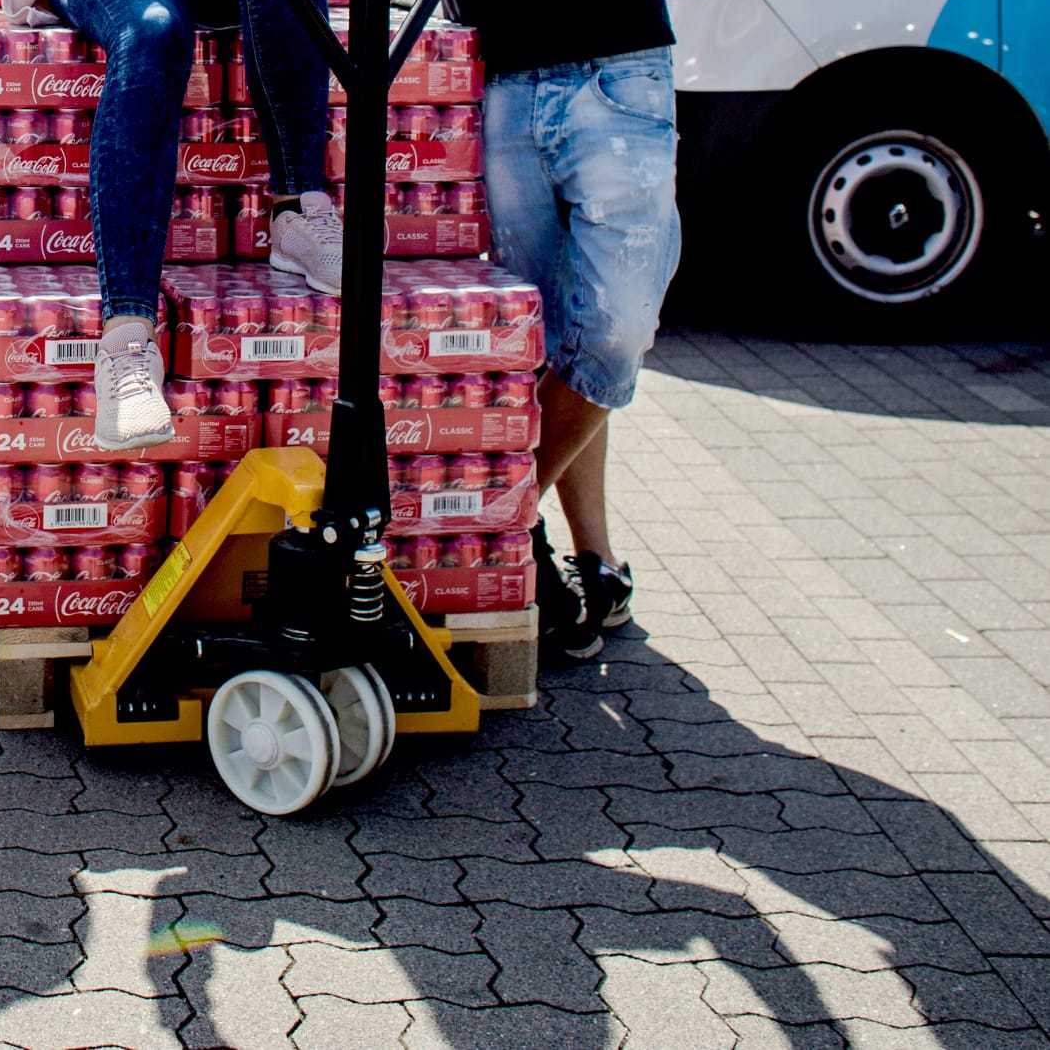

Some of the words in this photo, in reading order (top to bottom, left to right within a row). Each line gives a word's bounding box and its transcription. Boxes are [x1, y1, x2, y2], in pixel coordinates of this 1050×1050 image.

[8, 155, 62, 175] Coca-Cola
[187, 154, 241, 172] Coca-Cola
[46, 230, 95, 254] Coca-C
[255, 230, 271, 248] 2
[397, 232, 429, 240] CLASSIC
[170, 435, 190, 443] SSIC
[286, 427, 315, 445] 24
[439, 427, 473, 435] CLASSIC
[435, 587, 469, 595] CLASSIC
